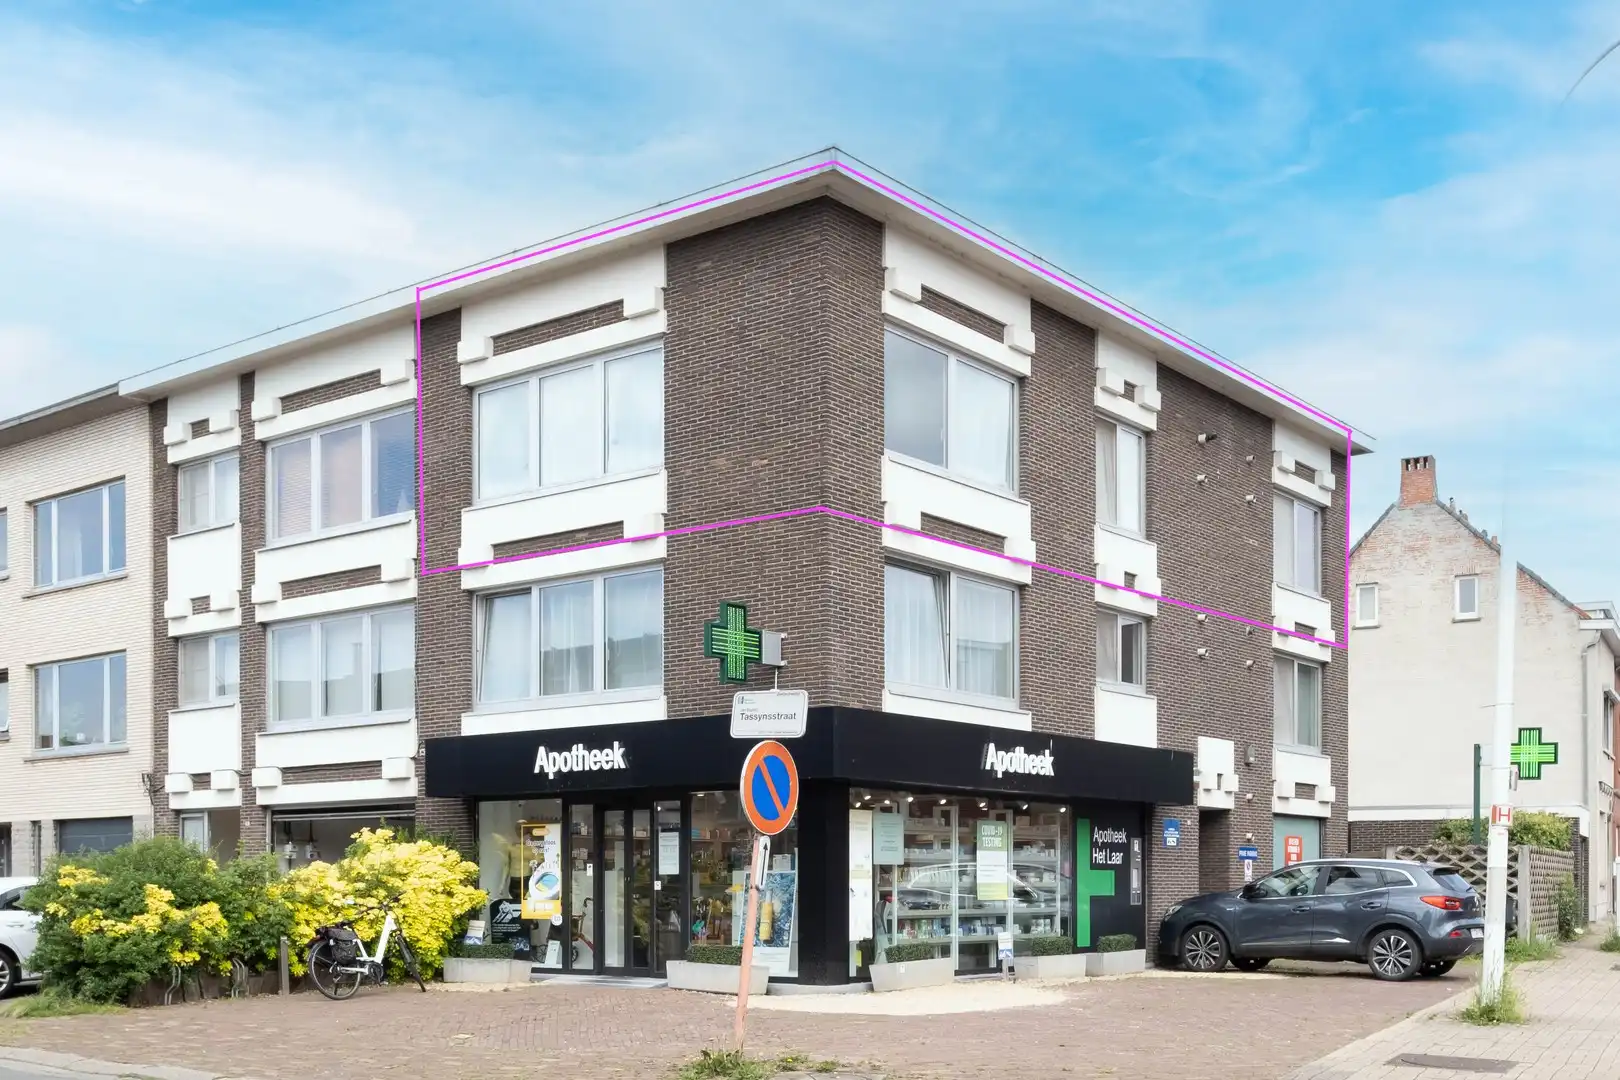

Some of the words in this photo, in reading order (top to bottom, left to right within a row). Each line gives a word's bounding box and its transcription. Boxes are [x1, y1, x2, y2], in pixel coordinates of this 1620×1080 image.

[740, 712, 797, 722] Tassynsstraat
[533, 741, 626, 780] Apotheek
[985, 742, 1055, 778] Apotheek
[1498, 807, 1511, 823] H
[981, 825, 1003, 836] COVID-19
[1092, 826, 1127, 846] Apotheek
[982, 836, 1002, 848] TESTING
[1092, 847, 1106, 864] Het
[1107, 848, 1123, 865] Laar
